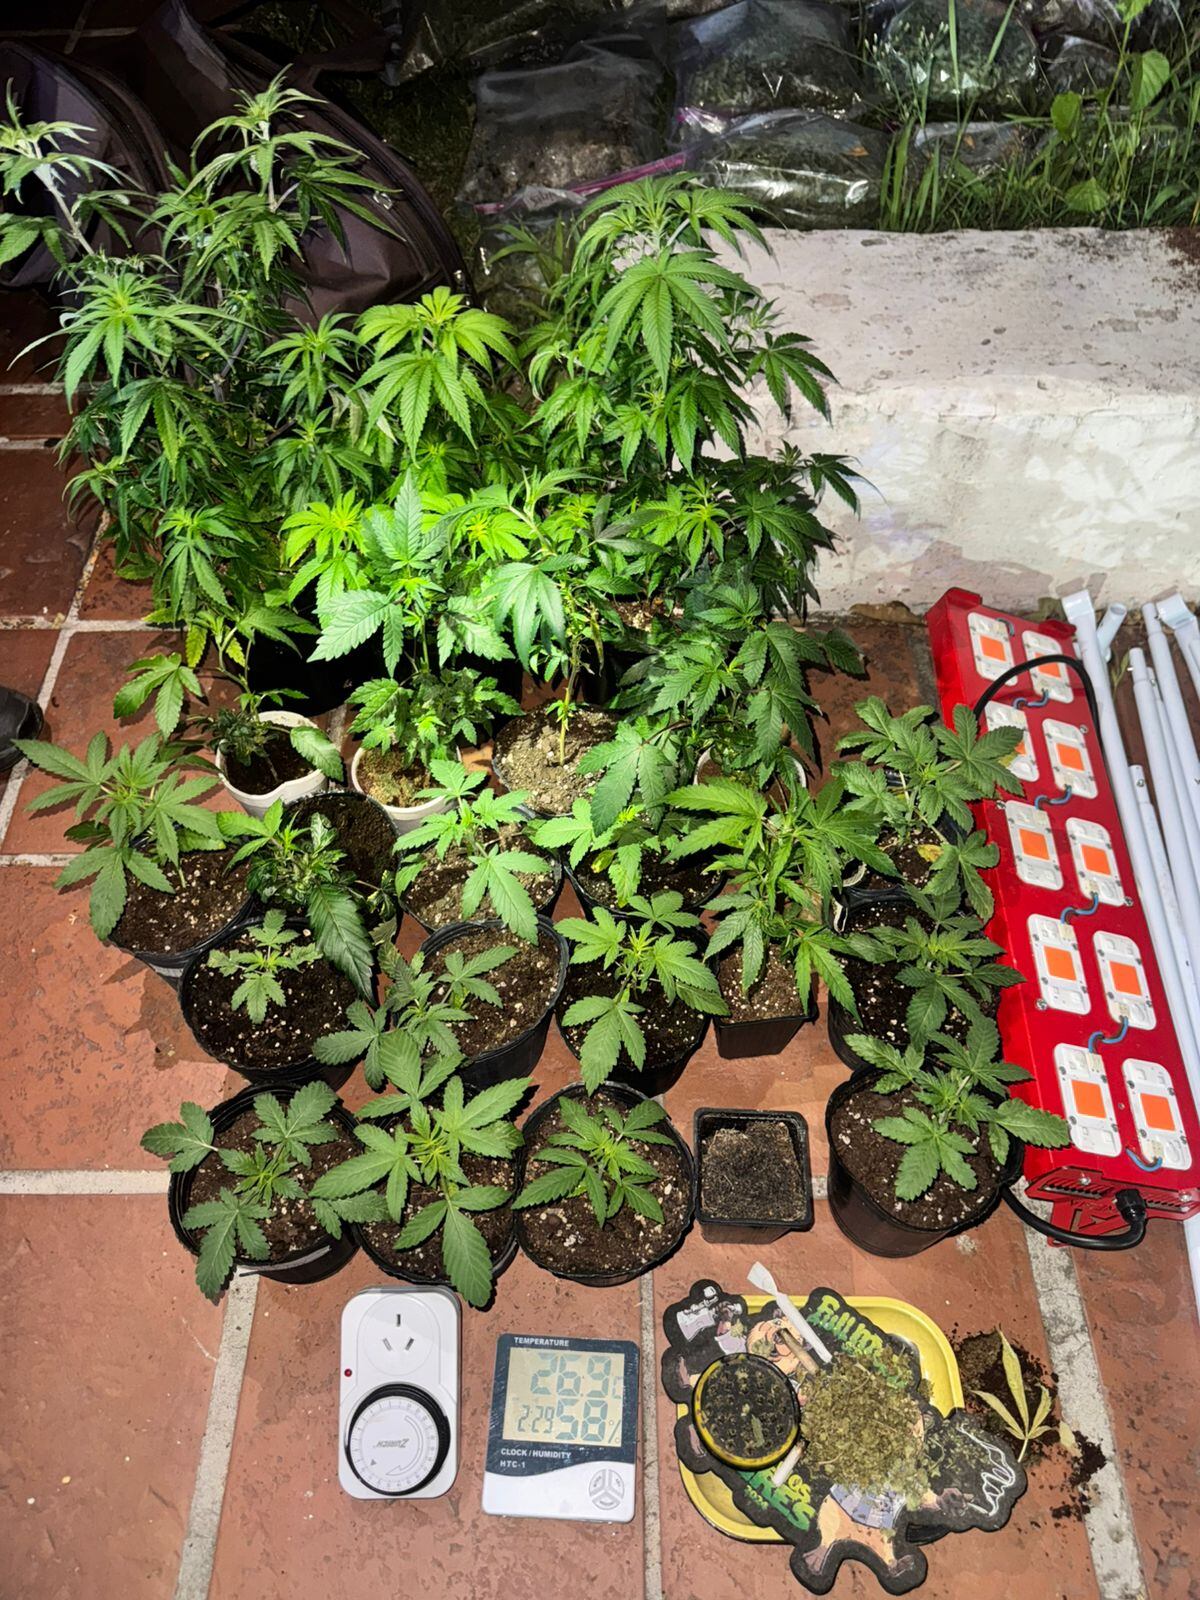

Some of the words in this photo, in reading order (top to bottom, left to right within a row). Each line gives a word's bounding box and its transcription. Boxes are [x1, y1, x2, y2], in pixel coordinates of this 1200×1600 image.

[514, 1337, 570, 1347] TEMPERATURE
[500, 1448, 527, 1457] CLOCK
[532, 1450, 572, 1459] HUMIDITY
[499, 1460, 526, 1468] HTC-1
